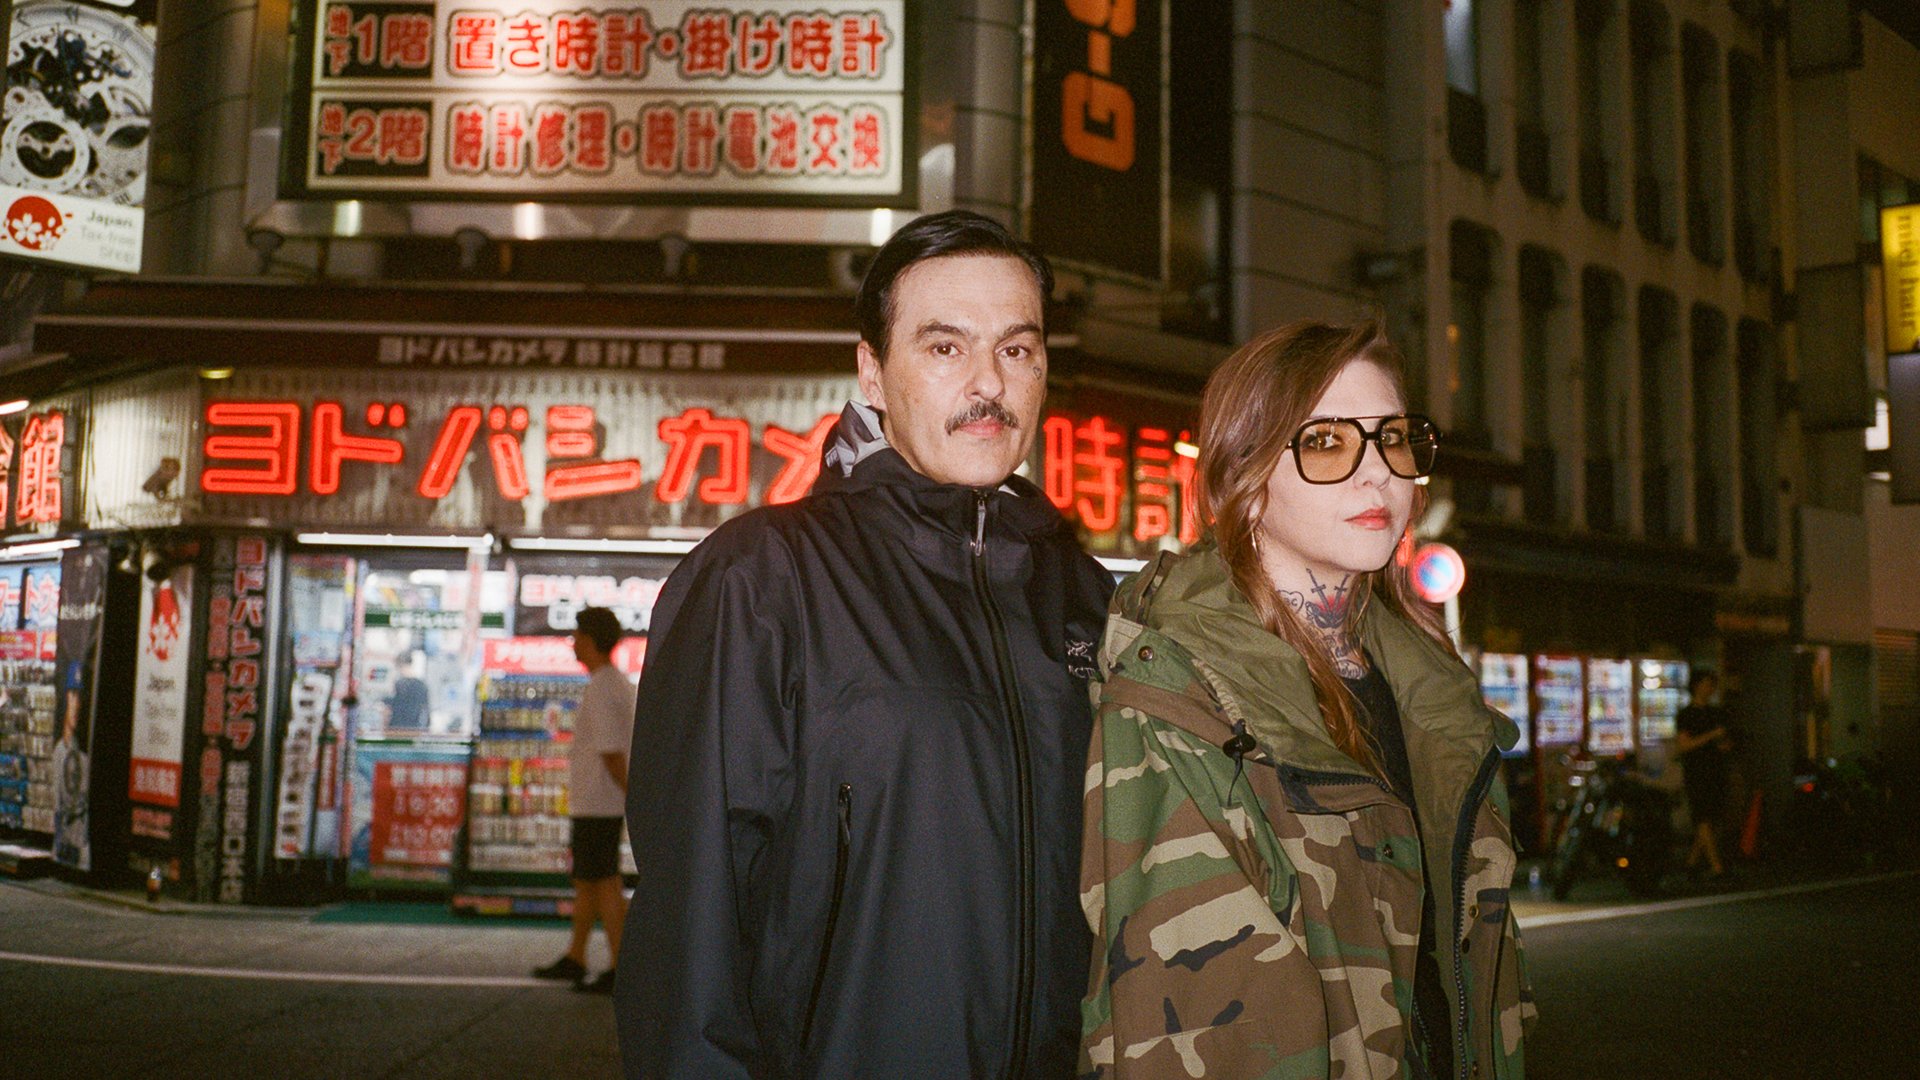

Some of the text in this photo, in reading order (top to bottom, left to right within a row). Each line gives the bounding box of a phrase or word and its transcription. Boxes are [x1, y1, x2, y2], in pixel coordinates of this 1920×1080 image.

[455, 17, 886, 73] 置き時計・掛け時計
[229, 536, 265, 749] ヨドバシカメラ
